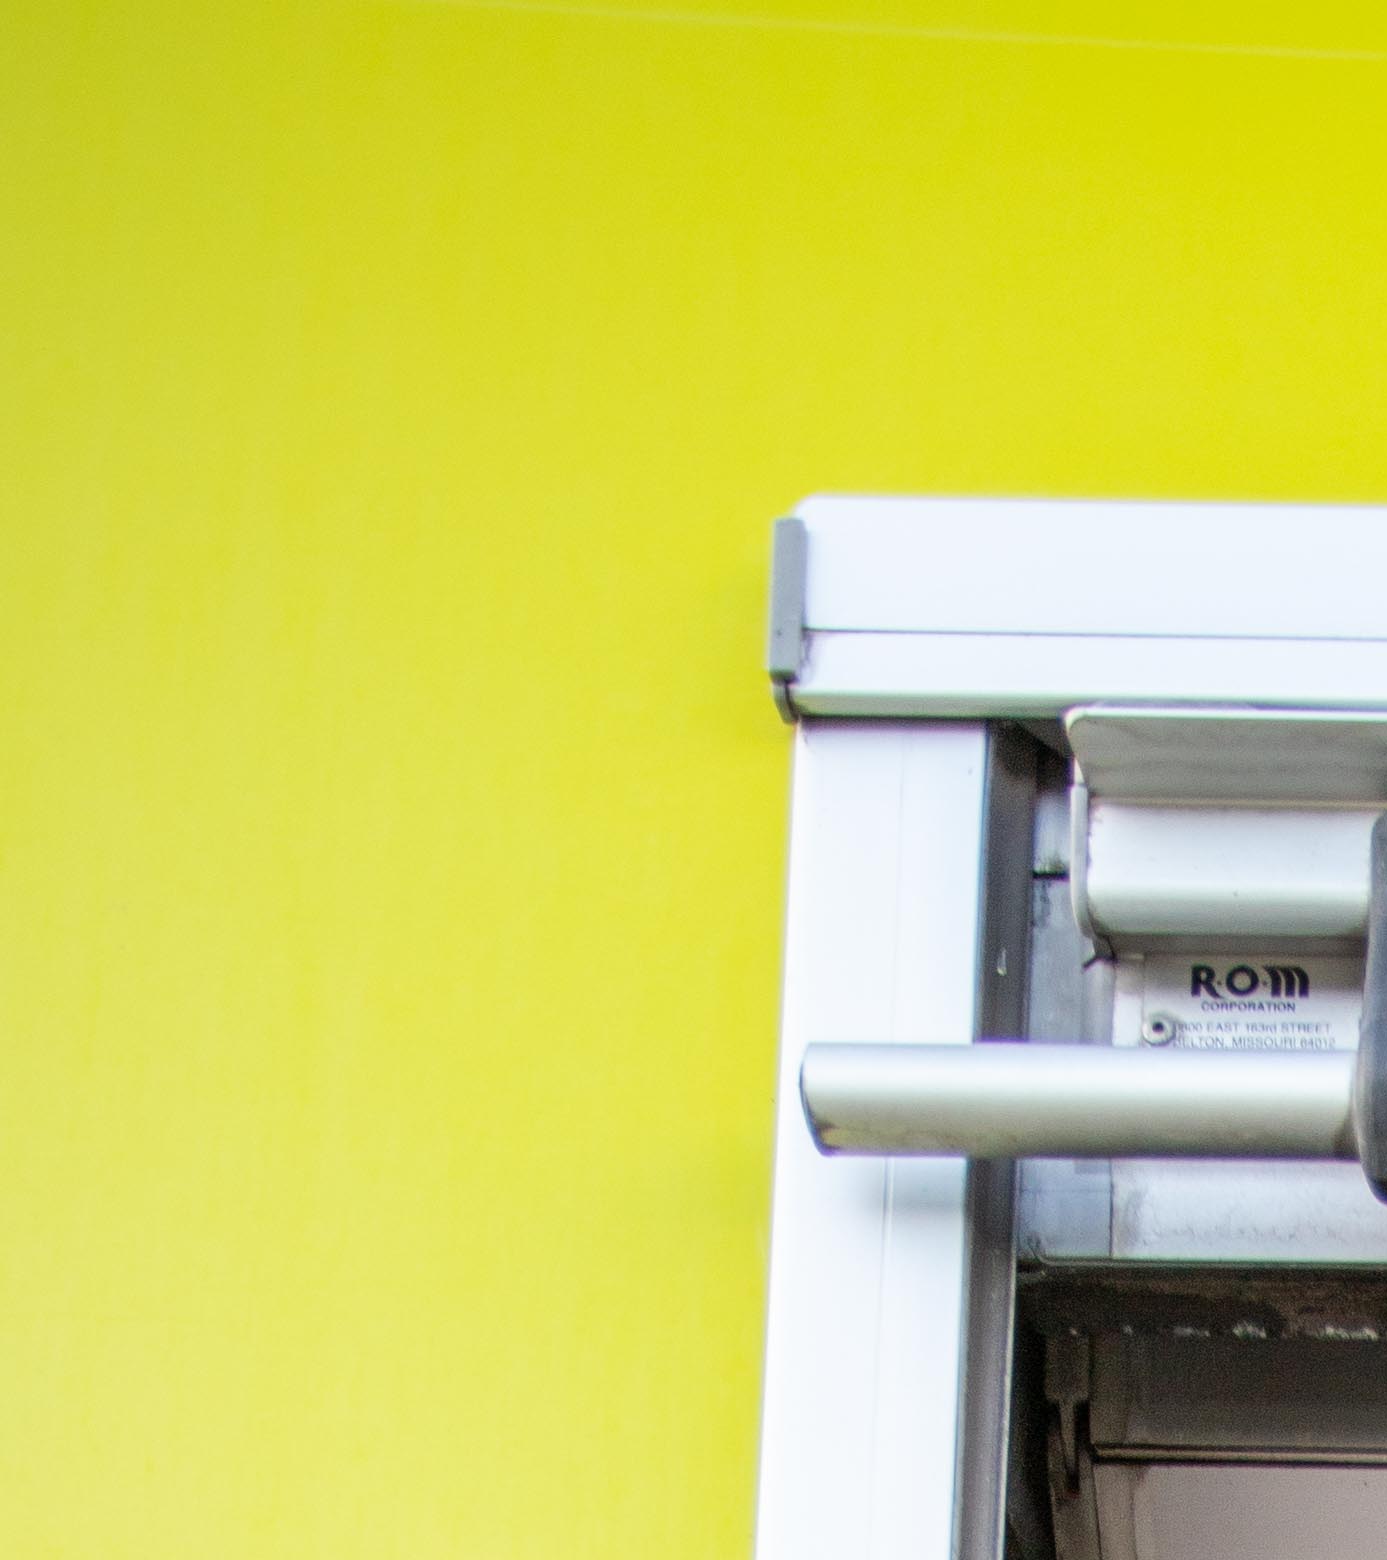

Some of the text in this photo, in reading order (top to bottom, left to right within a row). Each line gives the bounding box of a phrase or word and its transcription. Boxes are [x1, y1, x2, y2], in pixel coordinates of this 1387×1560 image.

[1200, 1000, 1297, 1013] CORPORATION
[1206, 1021, 1240, 1033] EAST
[1279, 1021, 1332, 1033] STREET
[1231, 1036, 1297, 1051] MISSOURI
